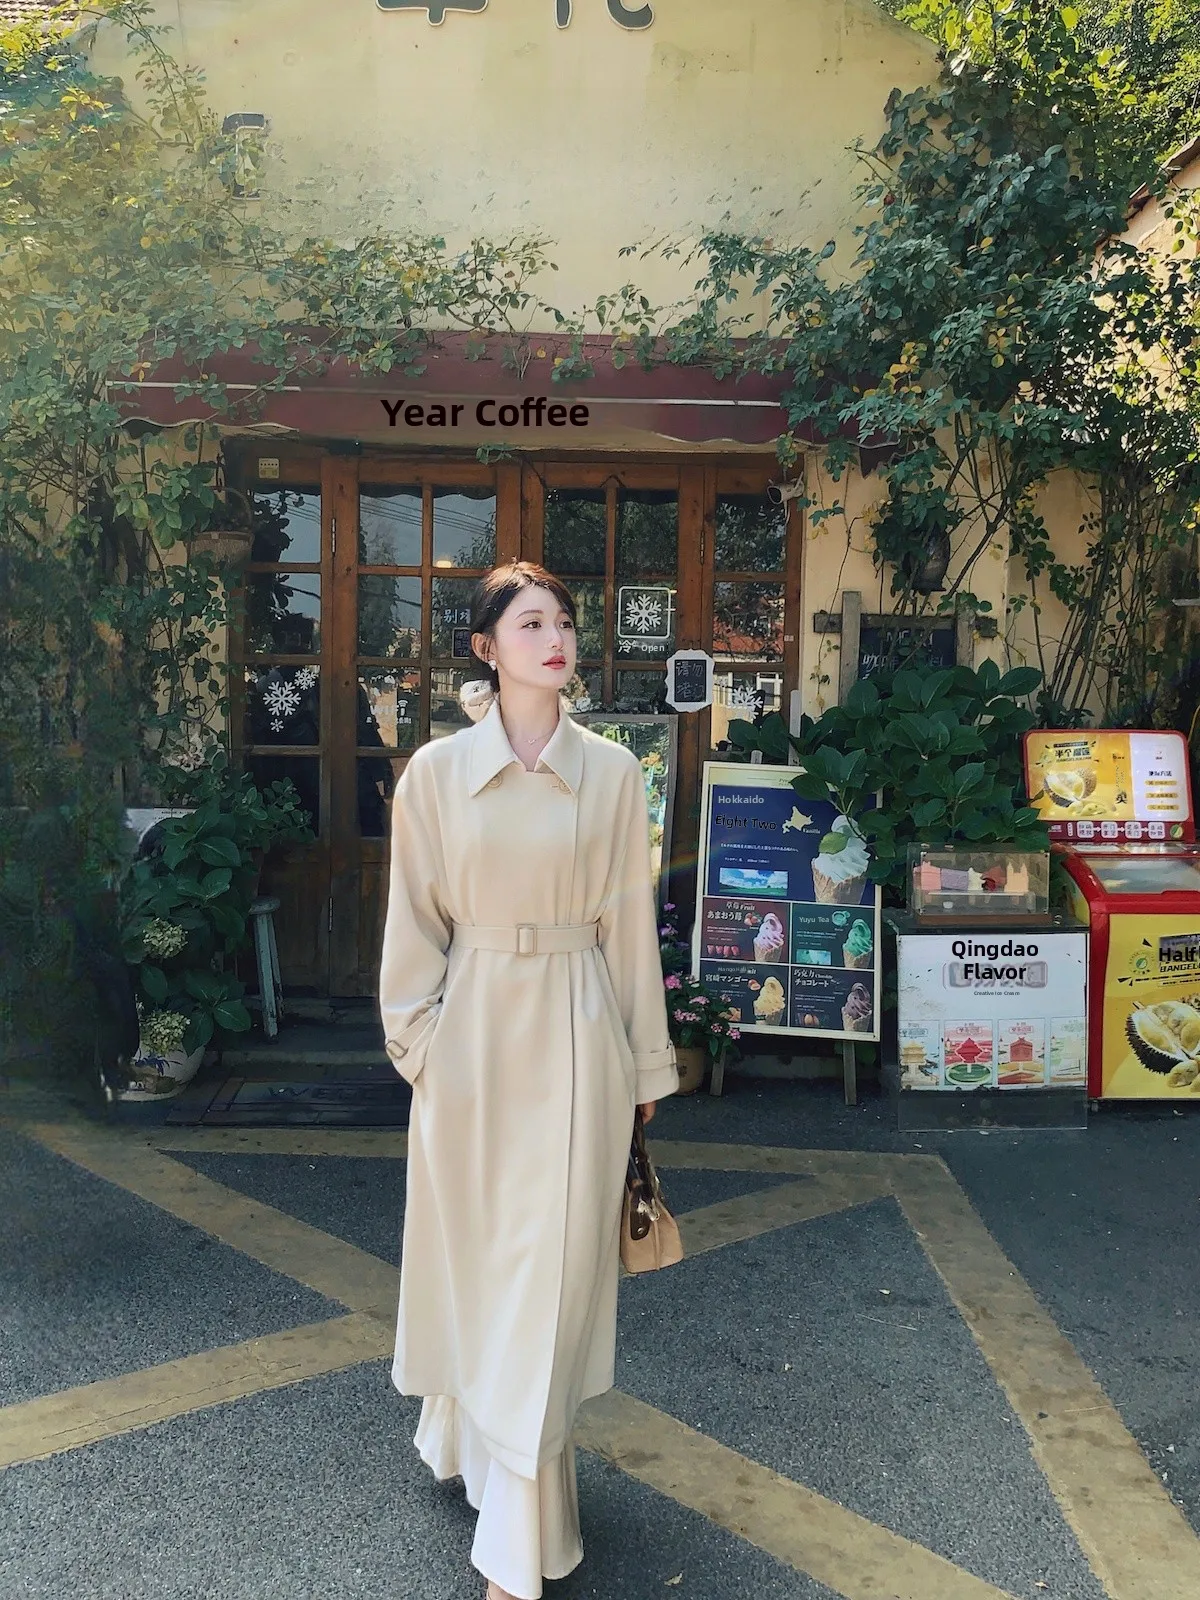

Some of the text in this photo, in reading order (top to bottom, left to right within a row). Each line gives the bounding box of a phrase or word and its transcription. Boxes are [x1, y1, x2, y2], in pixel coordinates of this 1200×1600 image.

[380, 396, 590, 427] Year Coffee
[641, 644, 665, 654] Open
[718, 795, 765, 804] Hokkaido
[715, 814, 777, 830] Eight Two
[952, 939, 1039, 961] Qingdao
[964, 963, 1026, 980] Flavor
[795, 978, 829, 987] チョコレート
